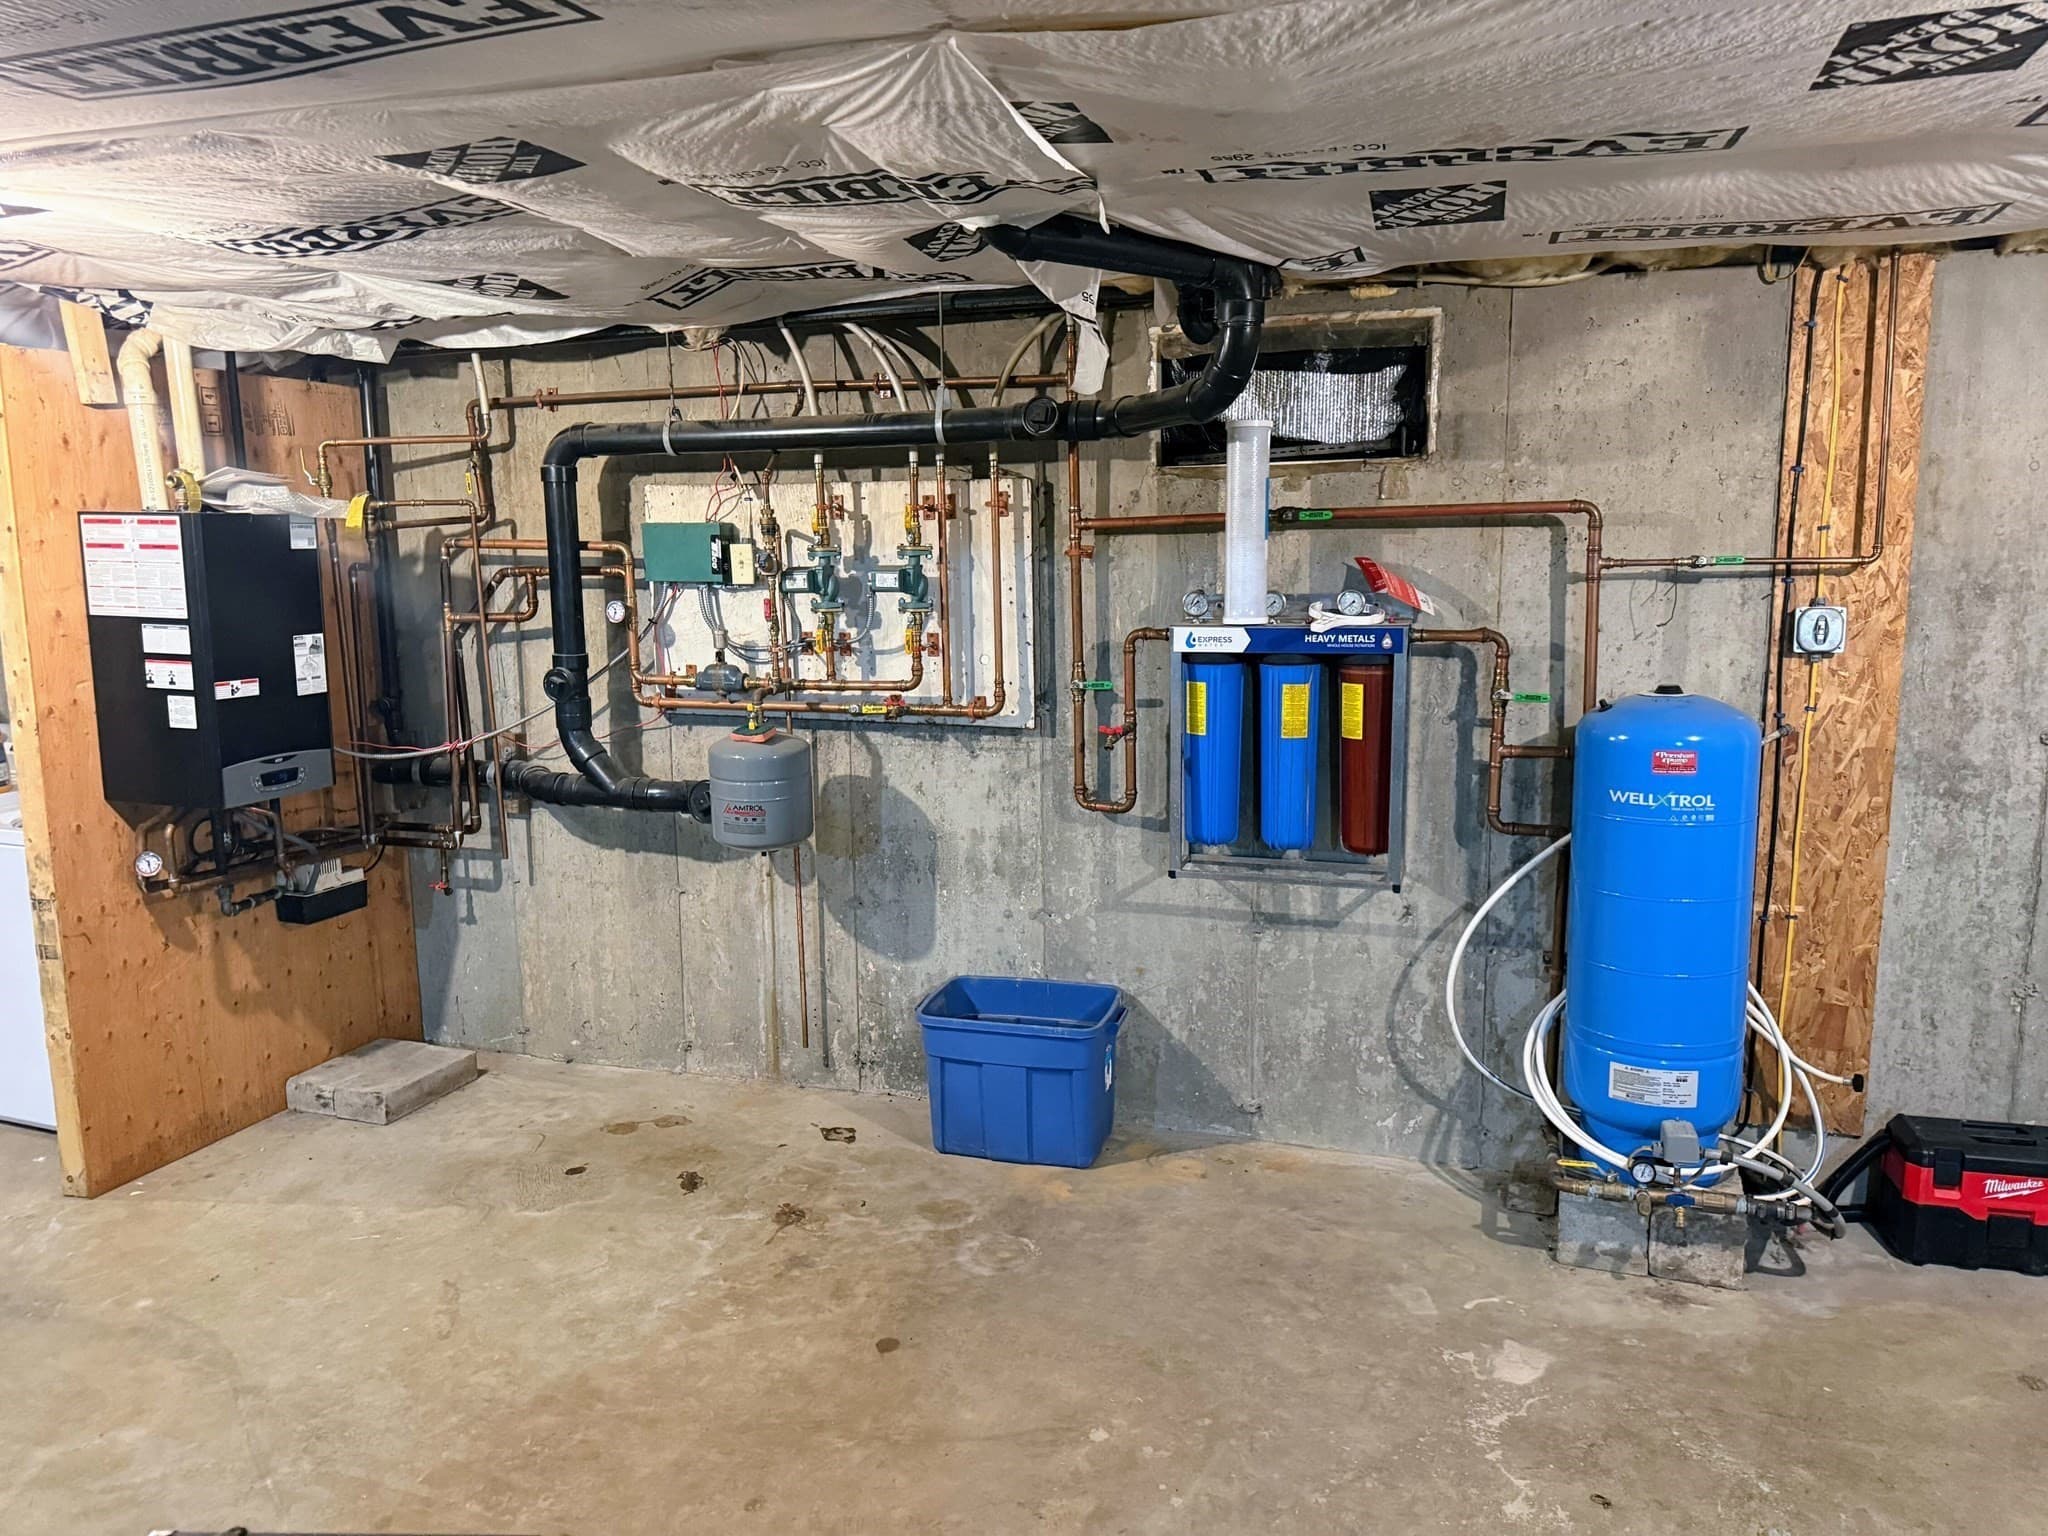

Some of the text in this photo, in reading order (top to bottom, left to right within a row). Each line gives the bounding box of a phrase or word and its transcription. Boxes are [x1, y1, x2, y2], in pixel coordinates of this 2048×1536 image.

[35, 0, 557, 93] EVERBILT
[1814, 4, 2048, 89] HOME
[1918, 42, 2022, 74] THE
[1218, 133, 1722, 183] EVERBILT
[1374, 183, 1507, 231] HOME
[1575, 207, 1978, 243] EVERBILT
[1304, 634, 1336, 643] HEAVY
[1338, 634, 1376, 643] METALS
[732, 804, 763, 812] AMTROL
[1982, 1178, 2045, 1194] Milwaukee
